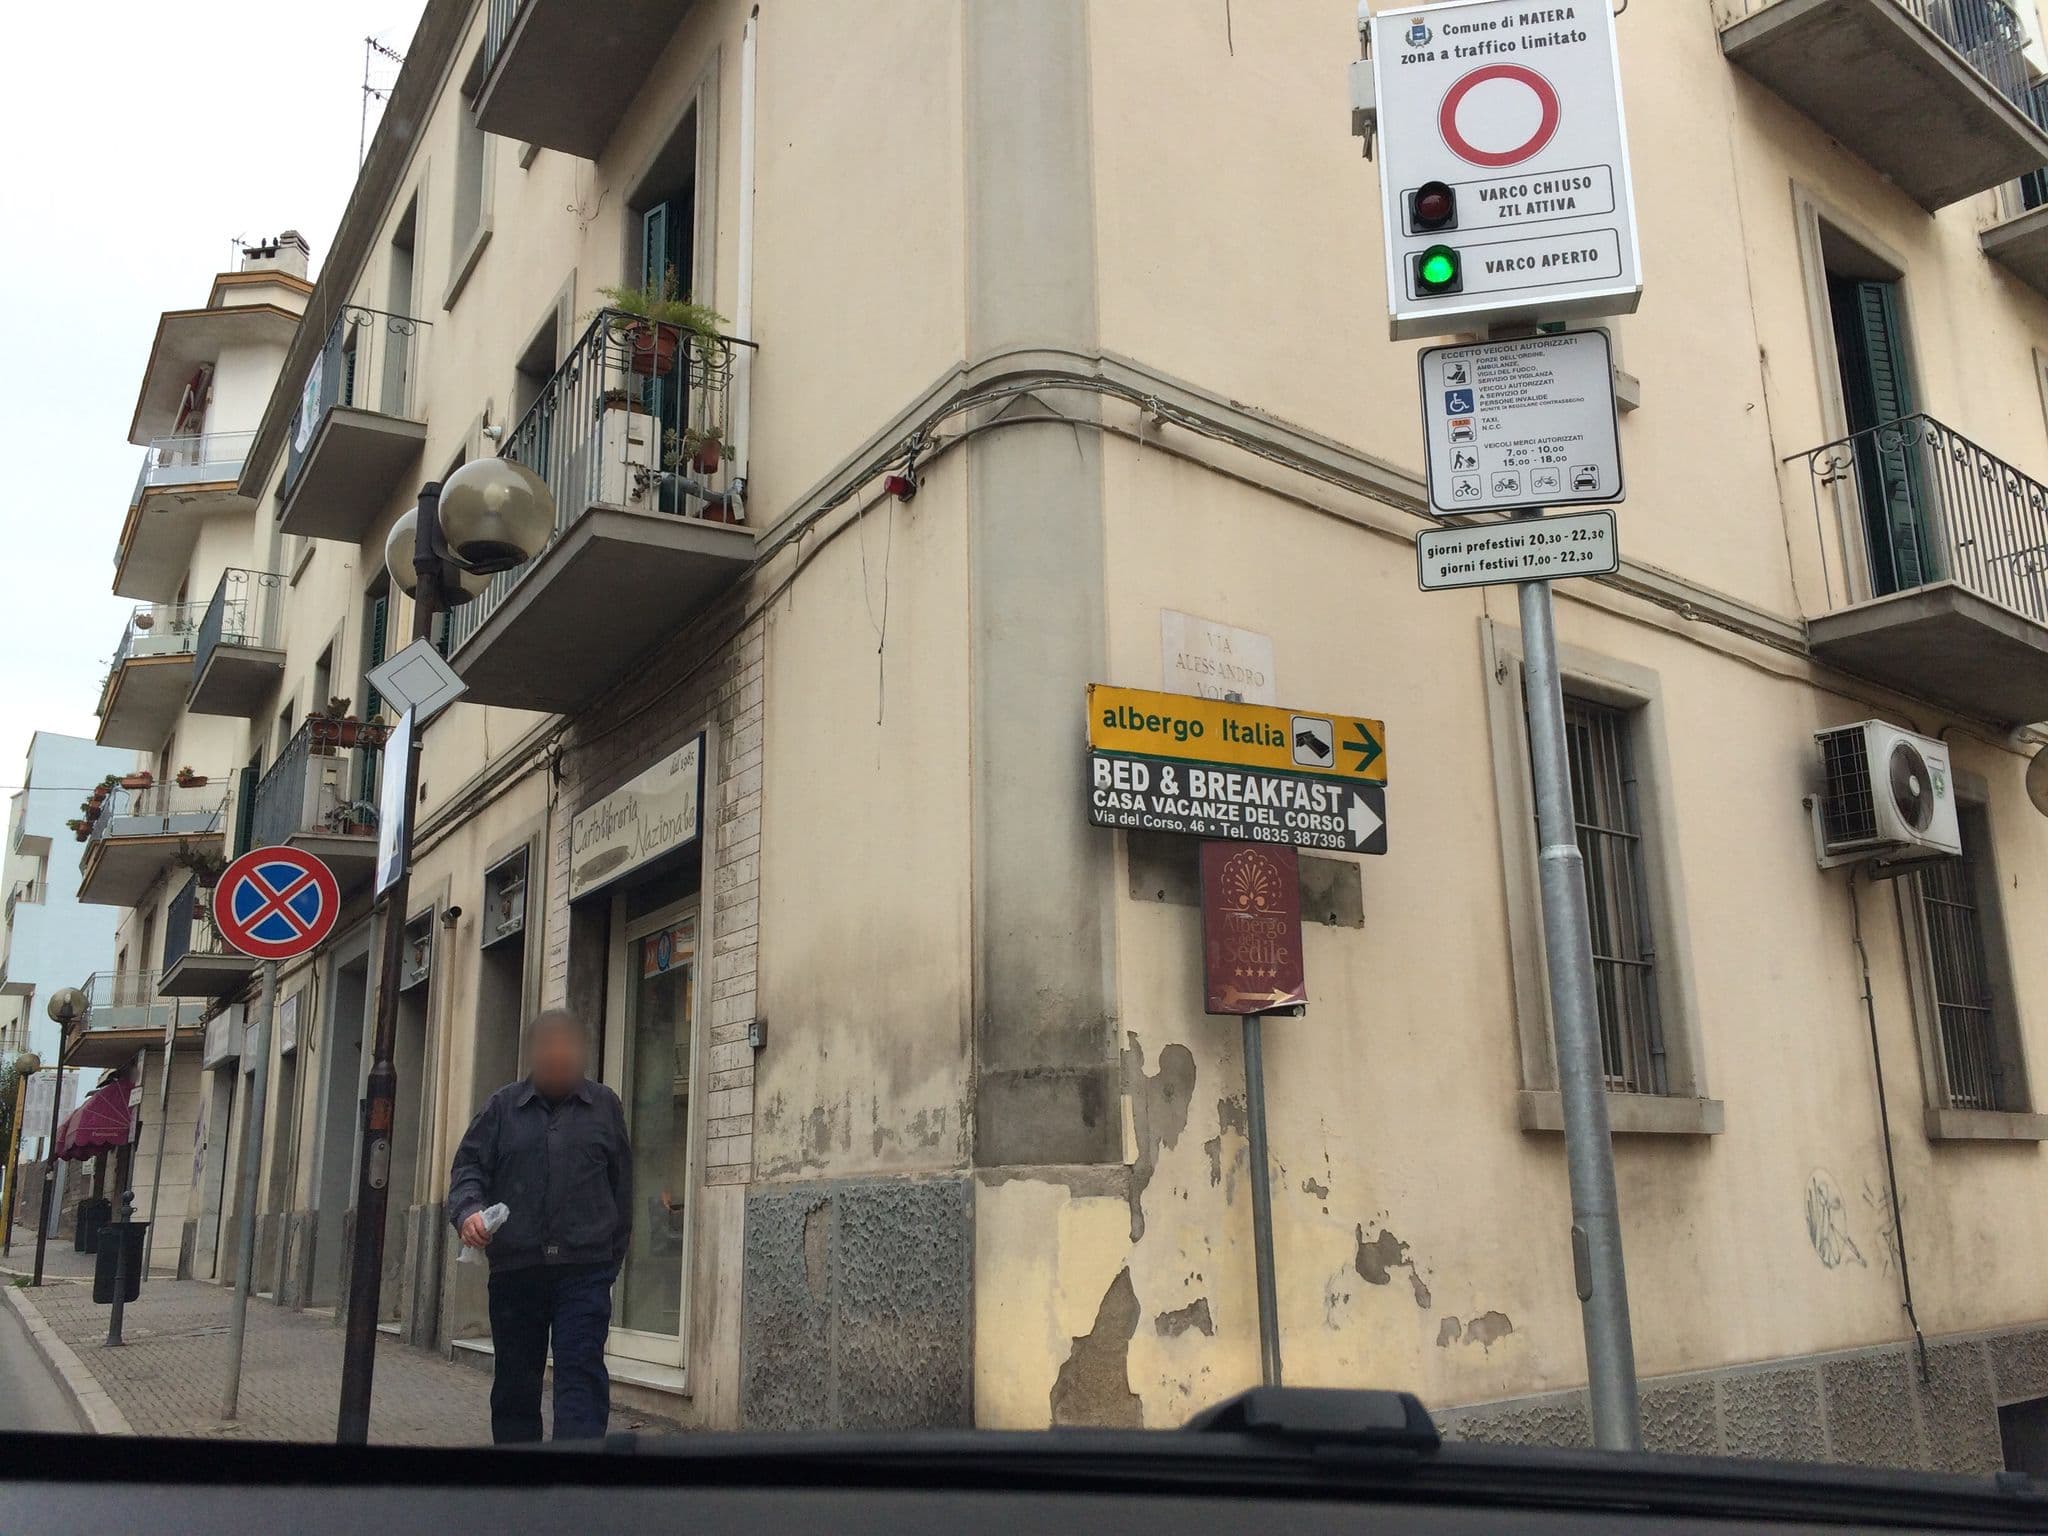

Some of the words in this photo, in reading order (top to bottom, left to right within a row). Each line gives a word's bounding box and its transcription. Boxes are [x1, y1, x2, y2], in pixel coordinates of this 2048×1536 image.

[1443, 20, 1497, 35] Comune
[1502, 17, 1513, 28] di
[1519, 8, 1574, 25] MATERA
[1401, 50, 1435, 64] zona
[1441, 49, 1449, 60] a
[1455, 41, 1516, 57] traffico
[1521, 32, 1587, 49] limitato
[1479, 185, 1528, 201] VARCO
[1534, 177, 1591, 194] CHIUSO
[1499, 205, 1521, 217] ZTL
[1527, 198, 1576, 214] ATTIVA
[1486, 257, 1535, 274] VARCO
[1542, 248, 1598, 267] APERTO
[1441, 349, 1481, 360] ECCETTO
[1484, 345, 1517, 355] VEICOLI
[1520, 338, 1577, 351] AUTORIZZATI
[1477, 361, 1519, 370] AMBULANZE,
[1517, 371, 1553, 380] VIGILANZA
[1479, 384, 1507, 392] VEICOLI
[1508, 379, 1554, 389] AUTORIZZATI
[1486, 390, 1518, 398] SERVIZIO
[1480, 397, 1513, 406] PERSONE
[1515, 394, 1548, 402] INVALIDE
[1484, 441, 1511, 449] VEICOLI
[1537, 435, 1583, 444] AUTORIZZATI
[1427, 543, 1462, 559] giorni
[1466, 536, 1525, 554] prefestivi
[1440, 561, 1475, 577] giorni
[1480, 557, 1518, 570] festivi
[1207, 632, 1232, 655] VIA
[1176, 653, 1265, 687] ALESSANDRO
[1103, 705, 1204, 741] albergo
[1222, 718, 1285, 747] Italia
[1093, 758, 1149, 792] BED
[1160, 766, 1180, 796] &
[1189, 769, 1343, 814] BREAKFAST
[1093, 792, 1146, 812] CASA
[1152, 797, 1240, 822] VACANZE
[1246, 808, 1280, 826] DEL
[1285, 812, 1344, 832] CORSO
[630, 792, 695, 860] Nazionale
[1094, 809, 1116, 824] Via
[1120, 812, 1140, 826] del
[1144, 814, 1187, 832] Corso,
[1190, 820, 1204, 832] 46
[1220, 823, 1248, 839] Tel.
[1253, 826, 1289, 843] 0835
[1294, 830, 1346, 848] 387396
[1223, 914, 1287, 939] Albergo
[1224, 938, 1288, 965] Sedile
